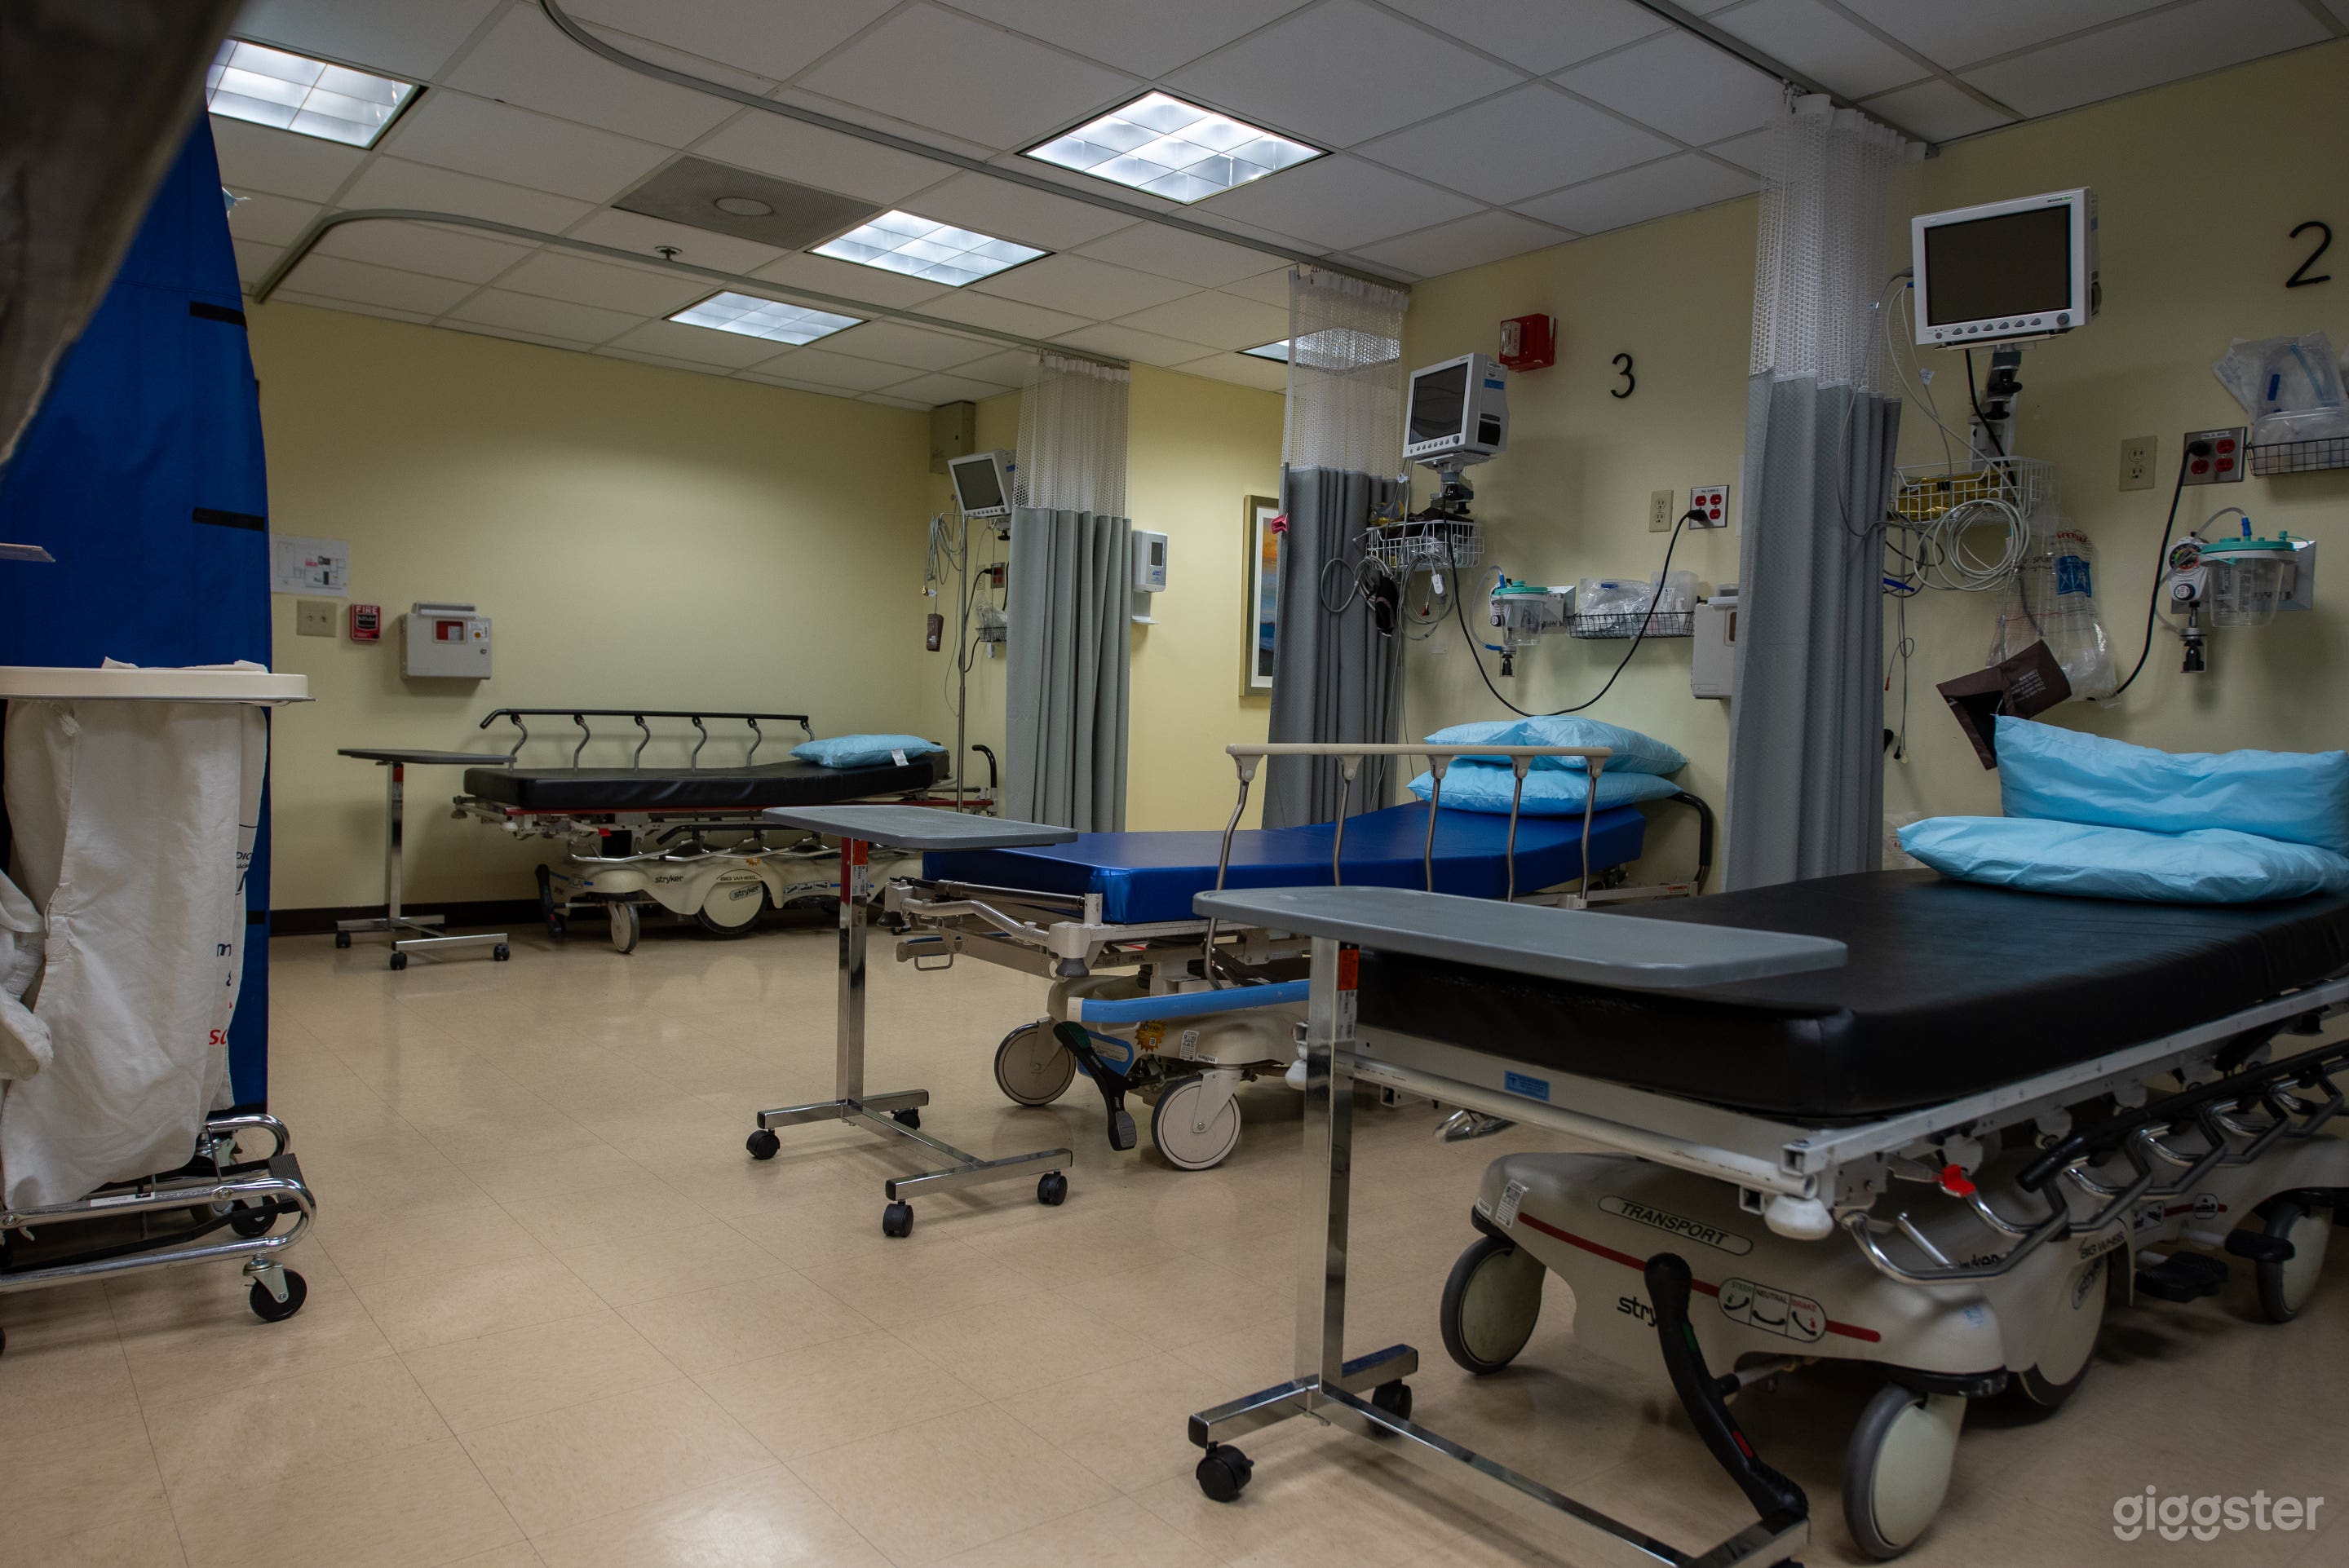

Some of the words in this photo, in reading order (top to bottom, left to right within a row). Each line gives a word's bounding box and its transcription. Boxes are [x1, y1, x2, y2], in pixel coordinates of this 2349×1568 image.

[2286, 221, 2332, 288] 2
[1611, 353, 1635, 399] 3
[356, 605, 378, 614] FIRE
[655, 875, 683, 884] stryker
[734, 885, 759, 899] stryker
[1621, 1202, 1729, 1245] TRANSPORT
[1617, 1296, 1656, 1327] stry
